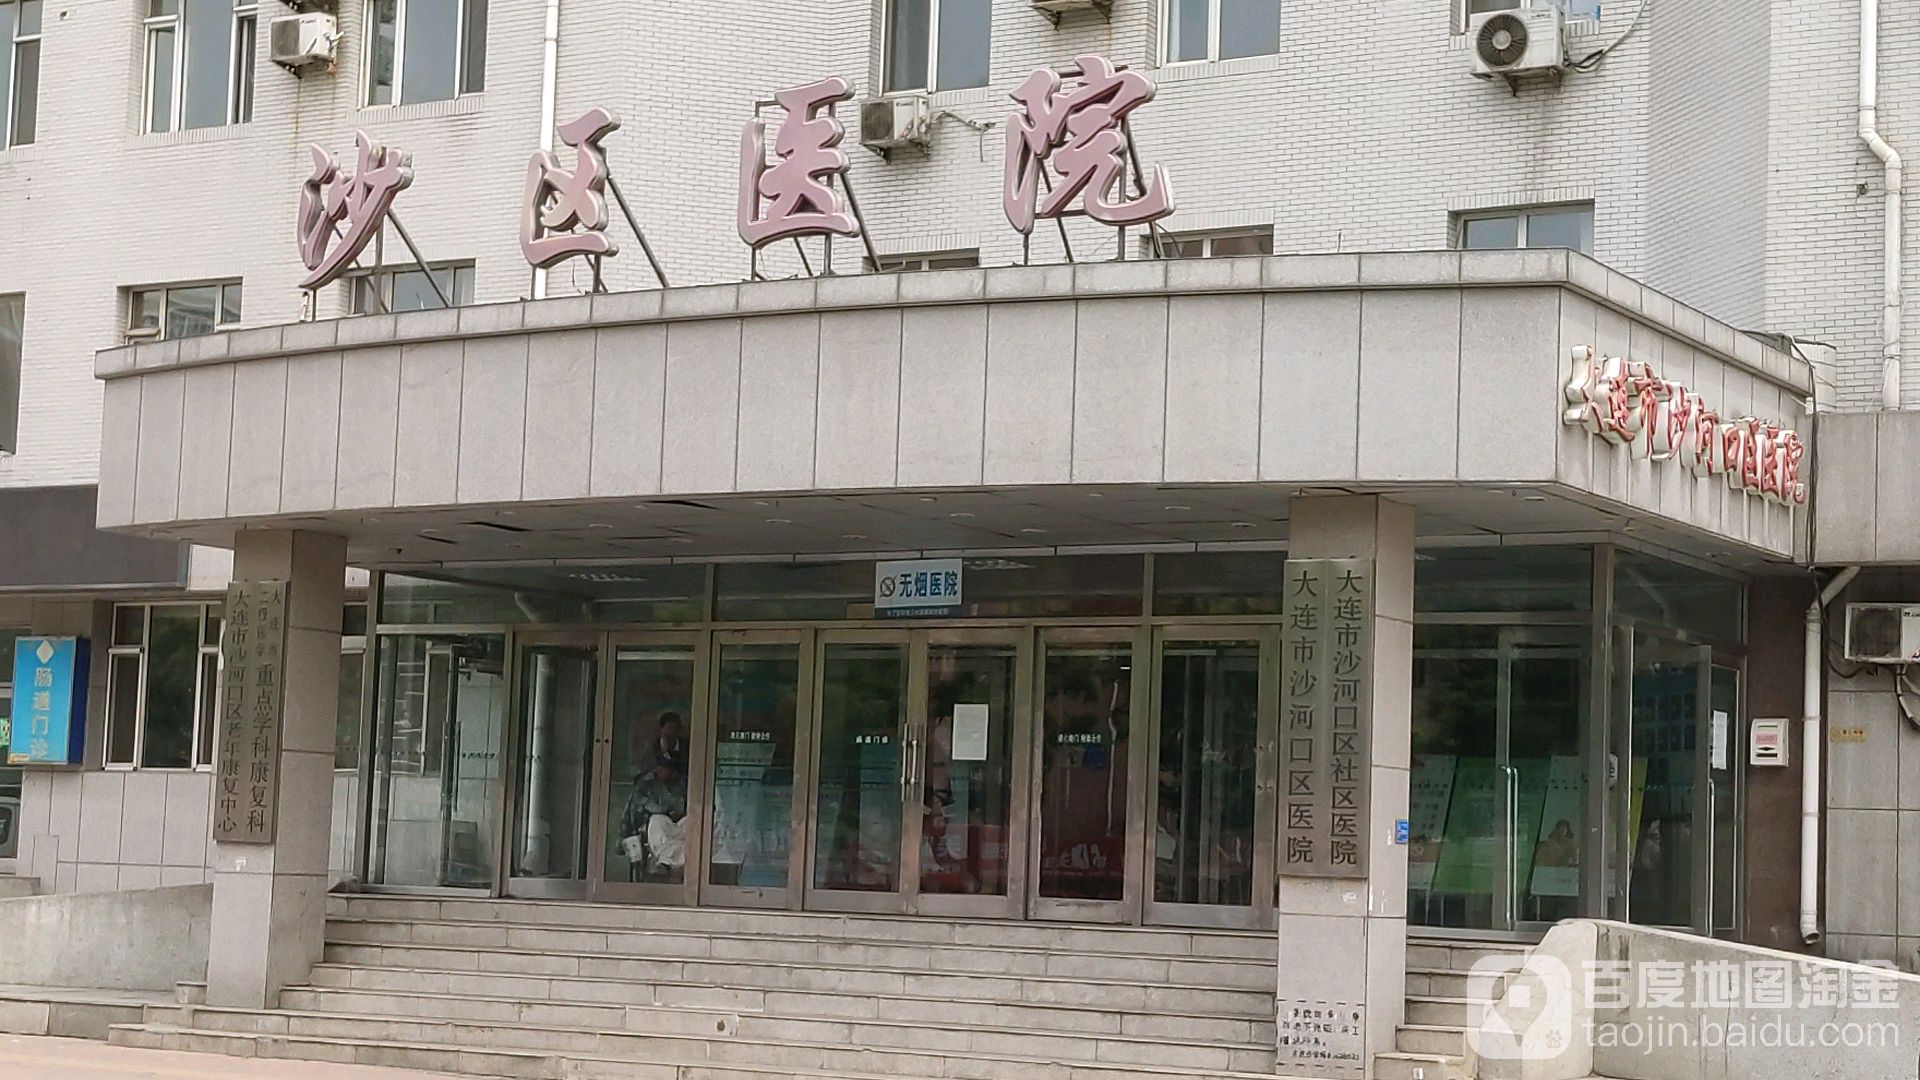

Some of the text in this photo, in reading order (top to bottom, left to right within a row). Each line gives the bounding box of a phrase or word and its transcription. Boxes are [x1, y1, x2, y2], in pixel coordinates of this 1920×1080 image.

[297, 55, 1175, 290] 沙区医院
[899, 570, 958, 598] 无烟医院
[217, 589, 250, 833] 大连市沙河口区老年康复中心
[247, 663, 275, 834] 重点学科康复科
[1287, 570, 1319, 864] 大连市沙河口区医院
[1330, 569, 1363, 865] 大连市沙河口区社区医院
